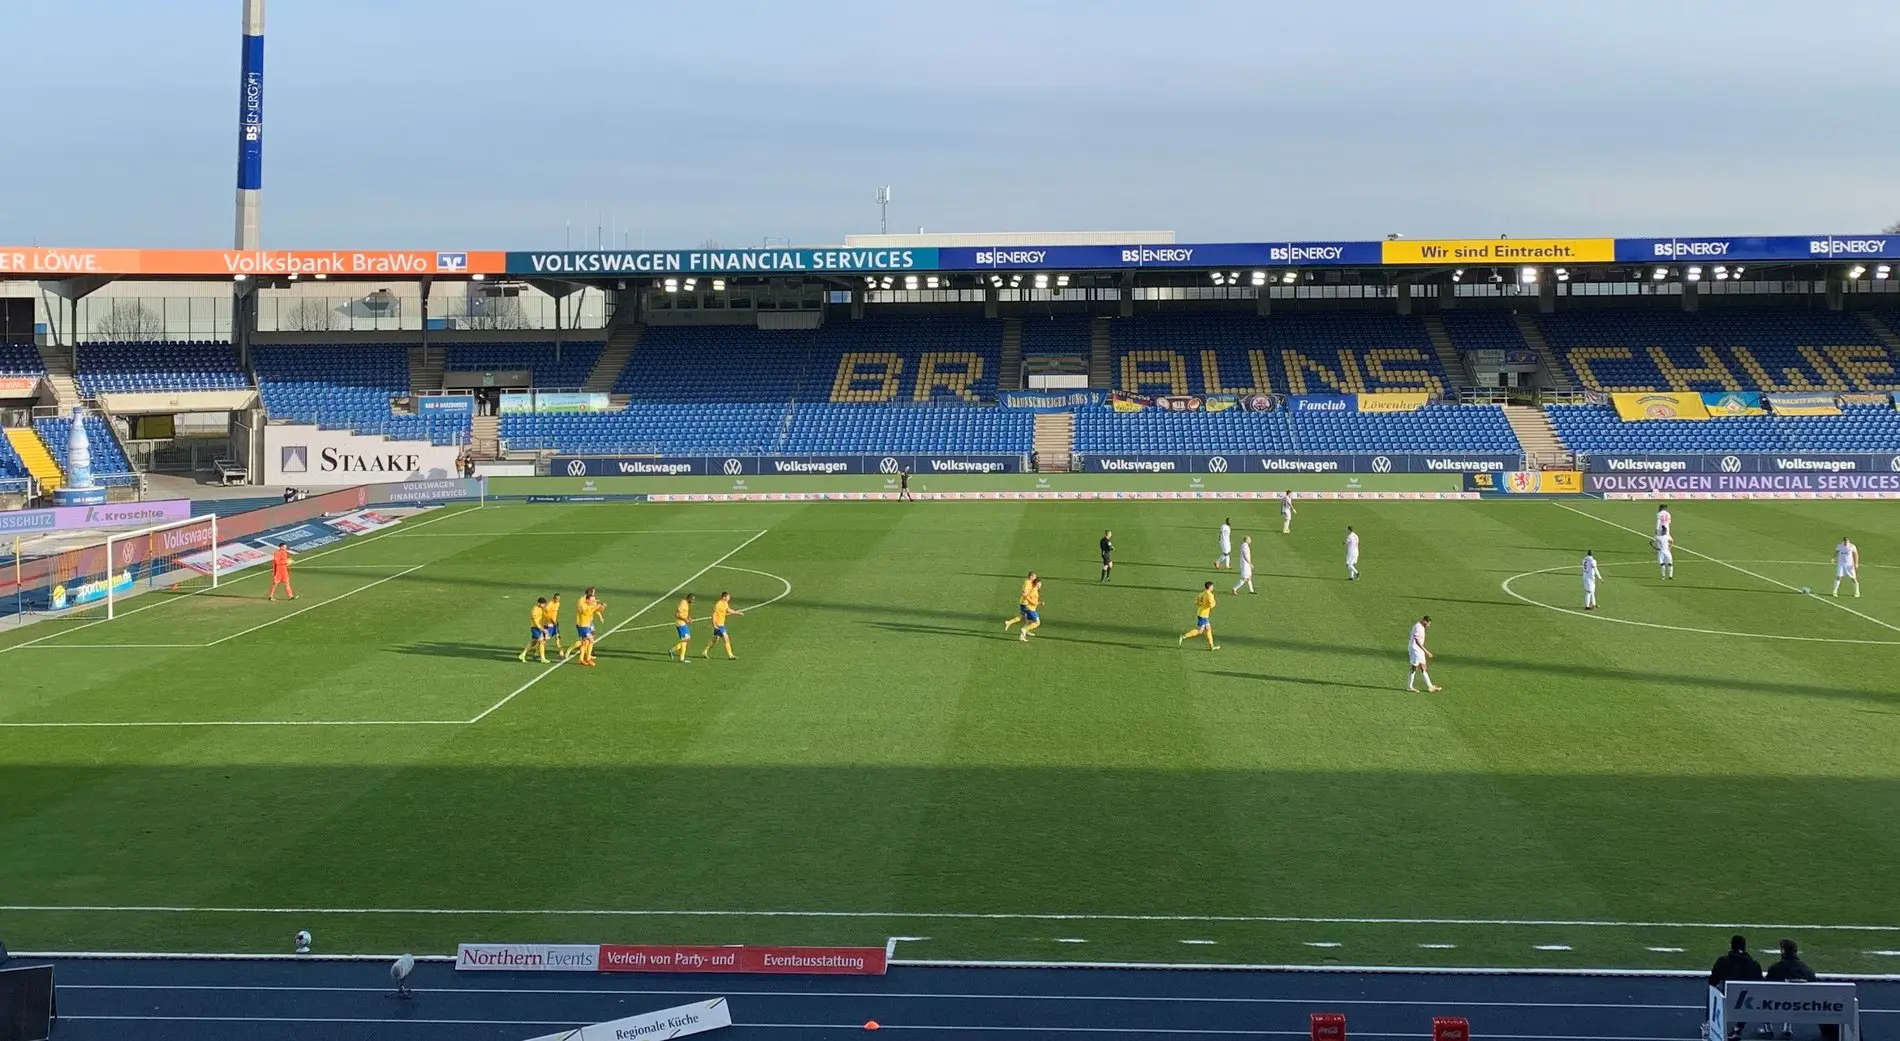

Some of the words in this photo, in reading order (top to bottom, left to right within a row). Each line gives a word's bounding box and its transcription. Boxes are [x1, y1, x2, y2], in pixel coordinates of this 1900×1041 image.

[1421, 245, 1449, 259] Wir
[1454, 244, 1489, 258] sind
[1495, 243, 1576, 258] Eintracht.
[33, 249, 102, 271] LÖWE.
[224, 252, 345, 272] Volksbank
[352, 253, 427, 272] BraWo
[531, 253, 680, 272] VOLKSWAGEN
[690, 252, 805, 271] FINANCIAL
[813, 251, 914, 269] SERVICES
[1298, 400, 1346, 410] Fanclub
[618, 461, 691, 475] Volkswagen
[775, 461, 847, 474] Volkswagen
[931, 460, 1004, 473] Volkswagen
[1101, 459, 1175, 473] Volkswagen
[1262, 458, 1337, 473] Volkswagen
[1426, 458, 1503, 473] Volkswagen
[1608, 458, 1686, 472] Volkswagen
[1776, 458, 1856, 472] Volkswagen
[403, 480, 455, 491] VOLKSWAGEN
[1592, 476, 1712, 490] VOLKSWAGEN
[1719, 475, 1812, 490] FINANCIAL
[1818, 475, 1900, 490] SERVICES
[390, 492, 431, 501] FINANCIAL
[433, 489, 468, 498] SERVICES
[462, 949, 543, 966] Northern
[546, 950, 593, 966] Events
[607, 953, 646, 965] Verleih
[650, 955, 671, 965] von
[675, 954, 709, 969] Party-
[712, 953, 735, 965] und
[764, 954, 864, 969] Eventausstattung
[615, 1021, 666, 1040] Regionale
[668, 1014, 699, 1029] Küche
